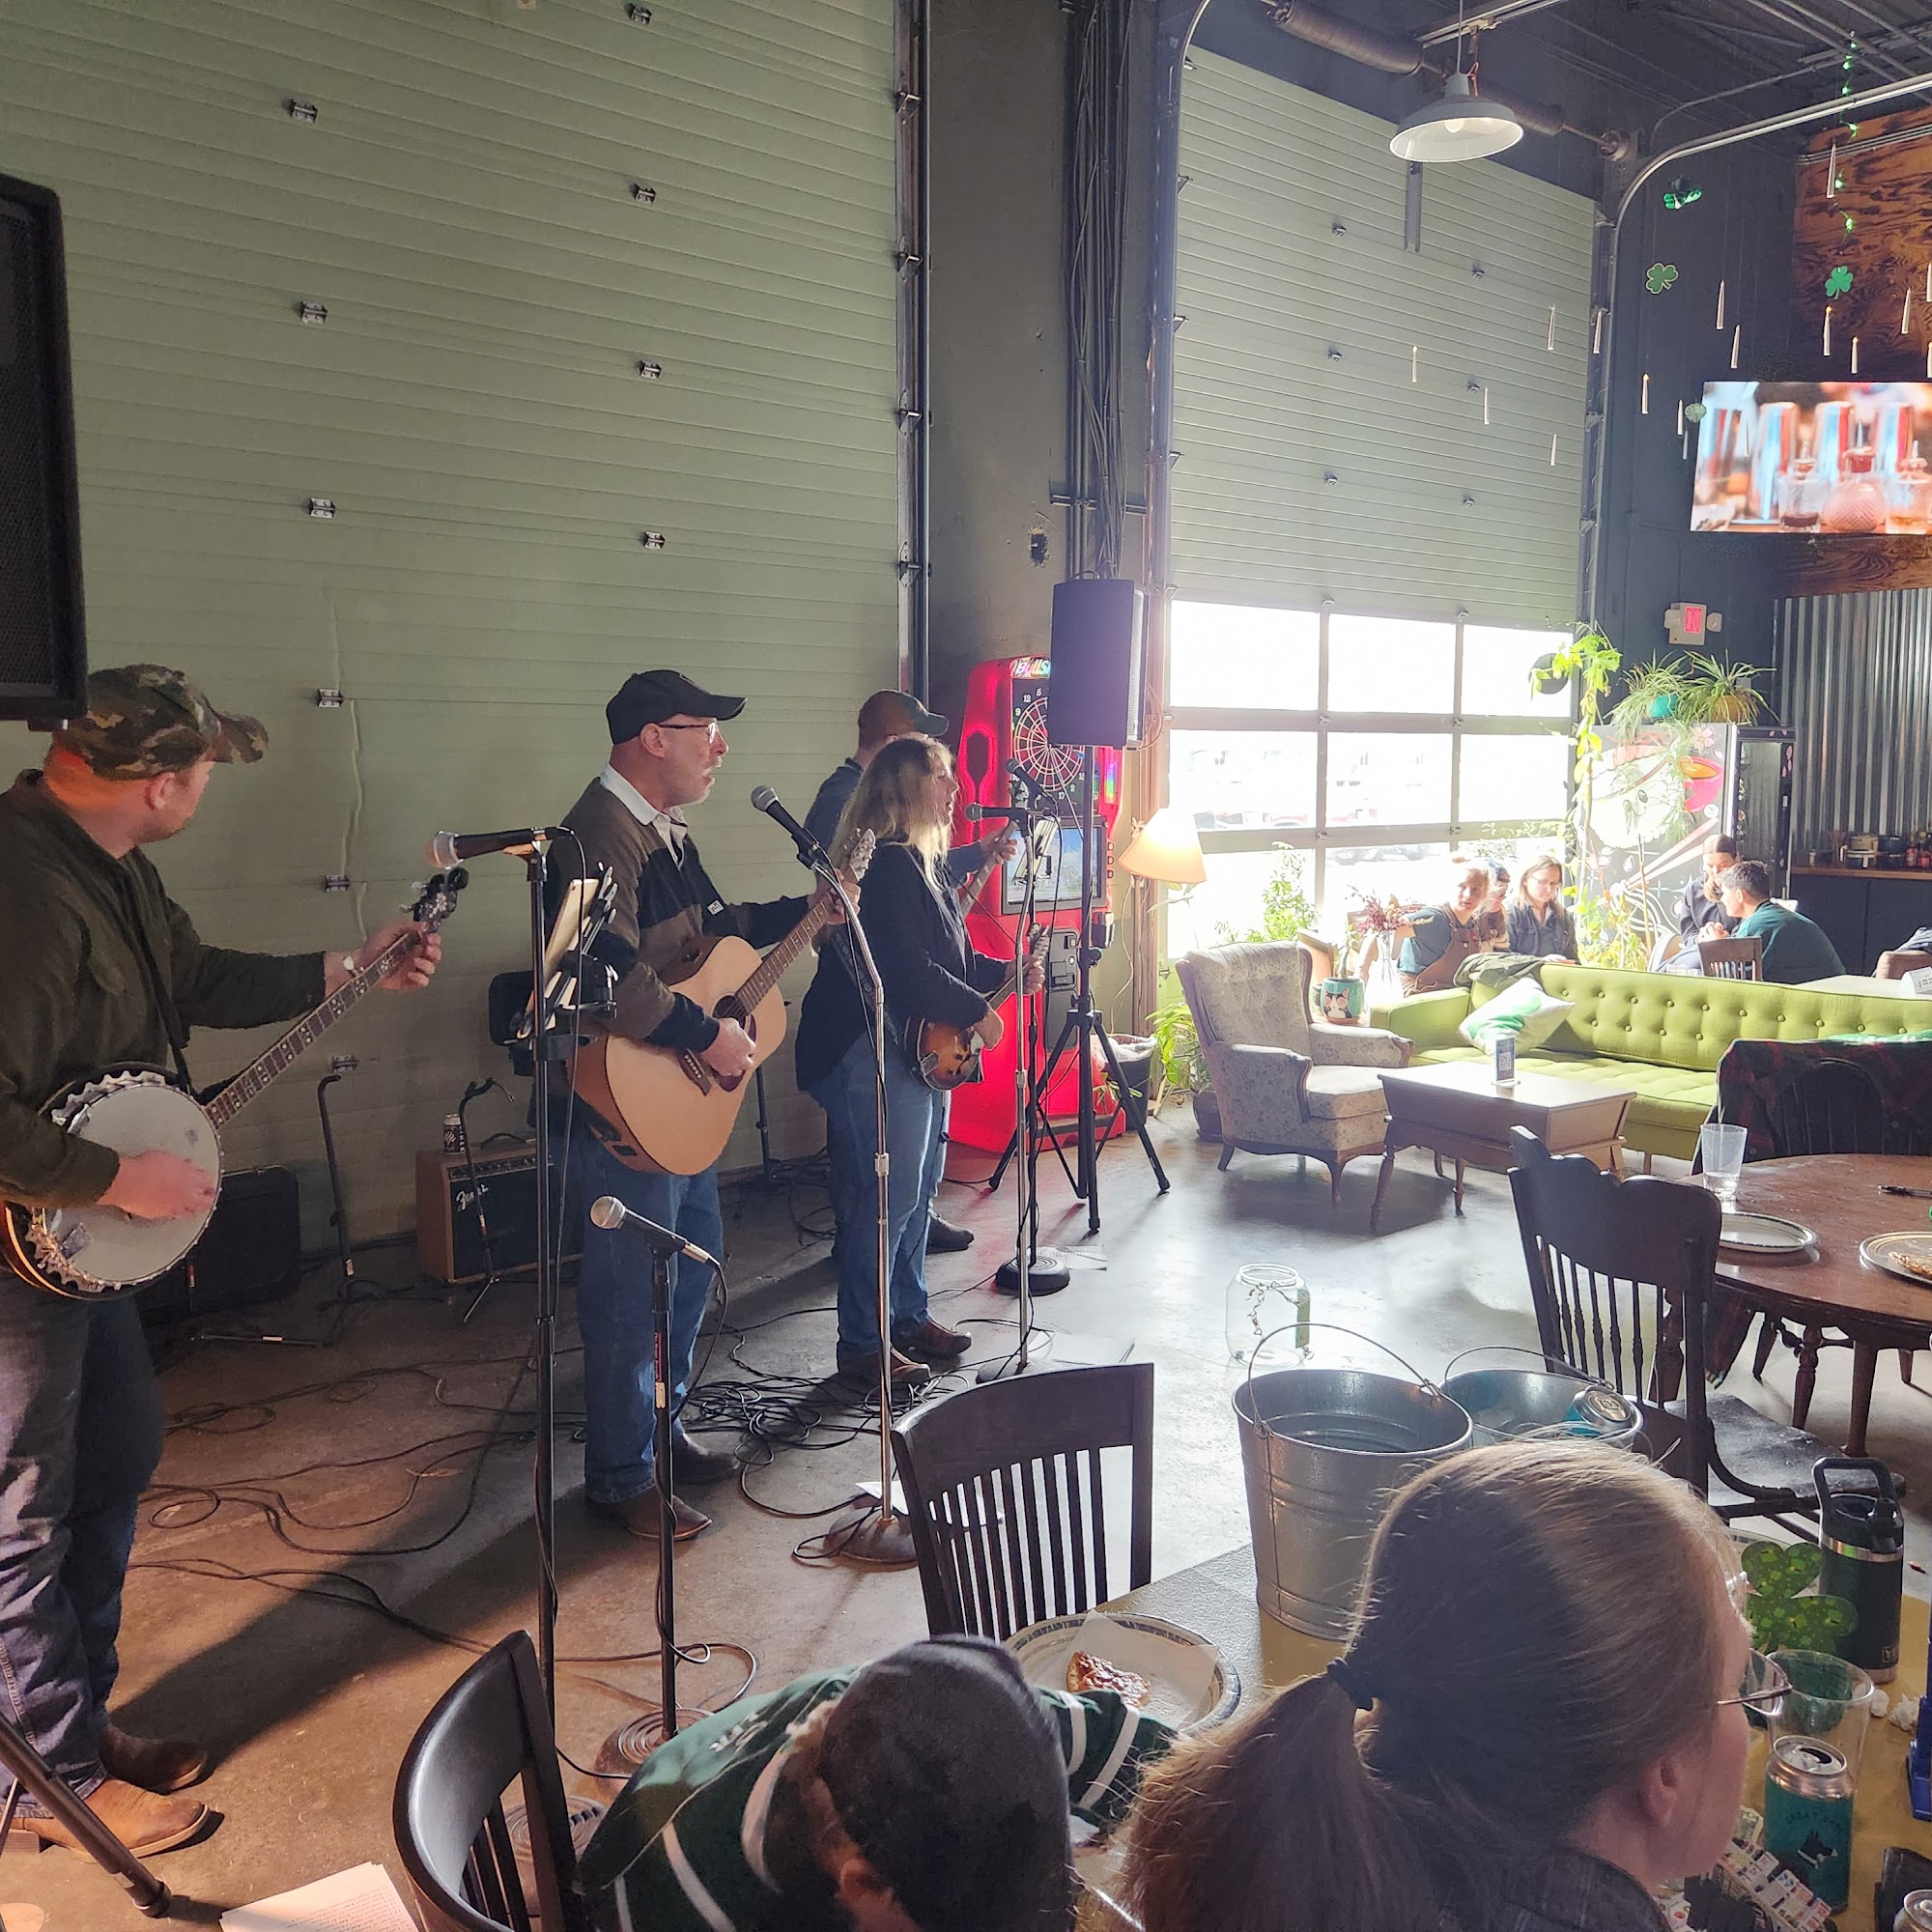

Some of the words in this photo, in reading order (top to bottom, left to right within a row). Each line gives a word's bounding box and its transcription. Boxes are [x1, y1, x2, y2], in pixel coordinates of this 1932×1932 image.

[1036, 688, 1042, 696] 5
[1023, 694, 1032, 703] 12
[1014, 707, 1021, 716] 9
[1069, 783, 1075, 792] 2
[455, 1183, 490, 1212] Fener
